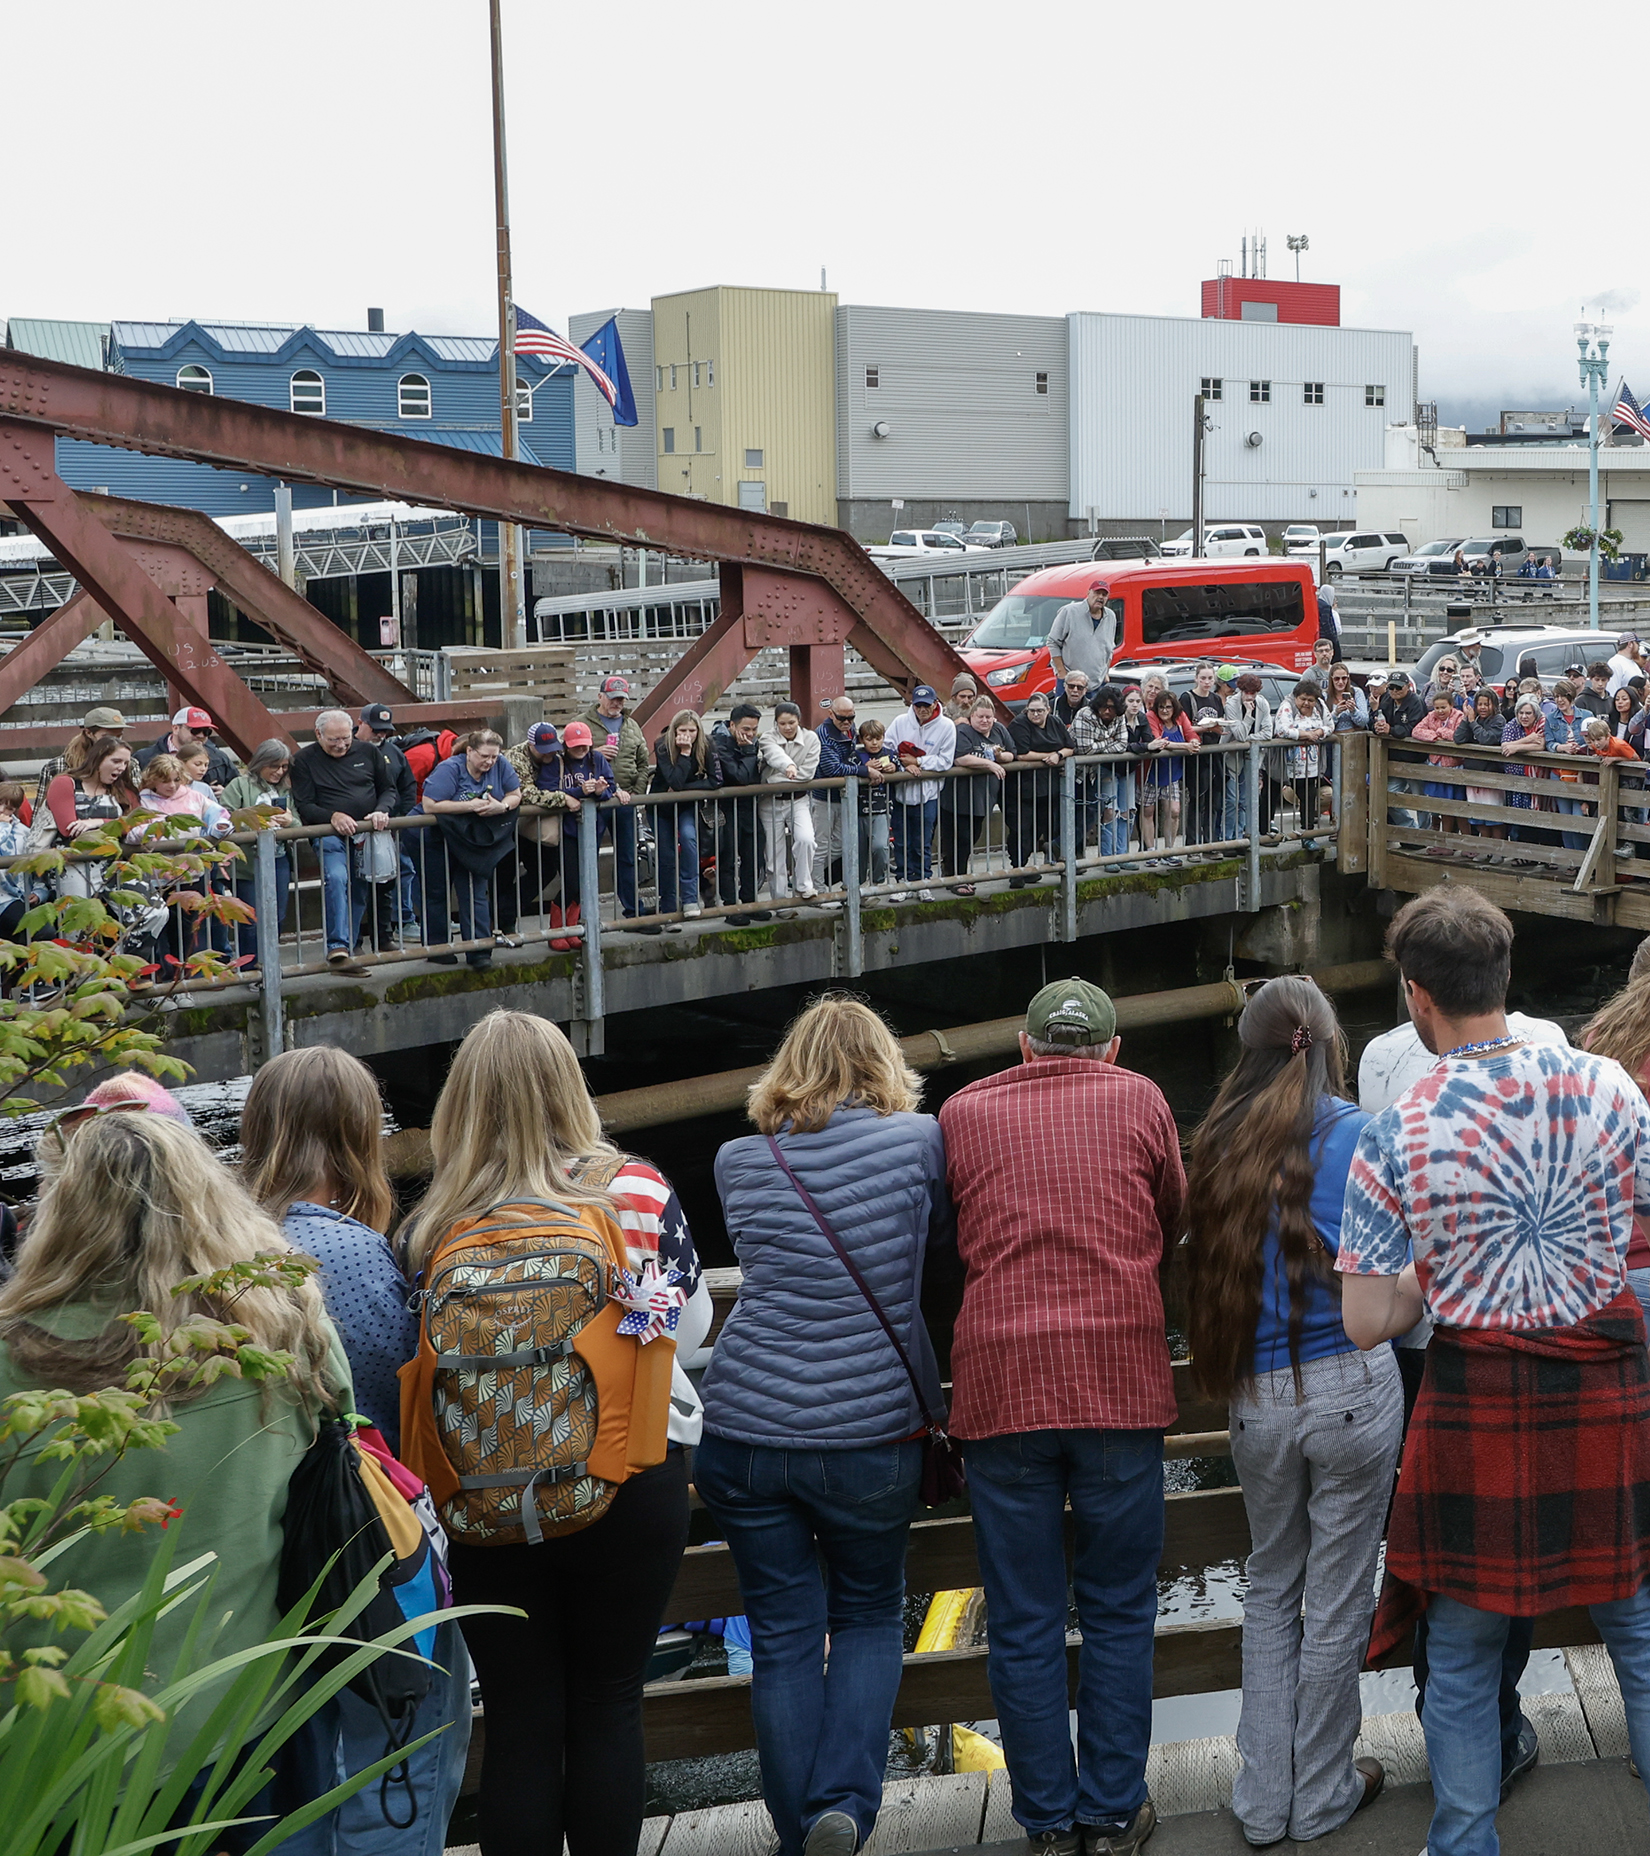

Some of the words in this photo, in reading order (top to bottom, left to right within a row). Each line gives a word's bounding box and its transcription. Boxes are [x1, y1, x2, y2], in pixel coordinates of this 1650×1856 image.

[167, 642, 194, 656] US
[683, 681, 703, 692] US
[1069, 1010, 1089, 1021] ALASKA
[495, 1305, 533, 1318] OSPREY
